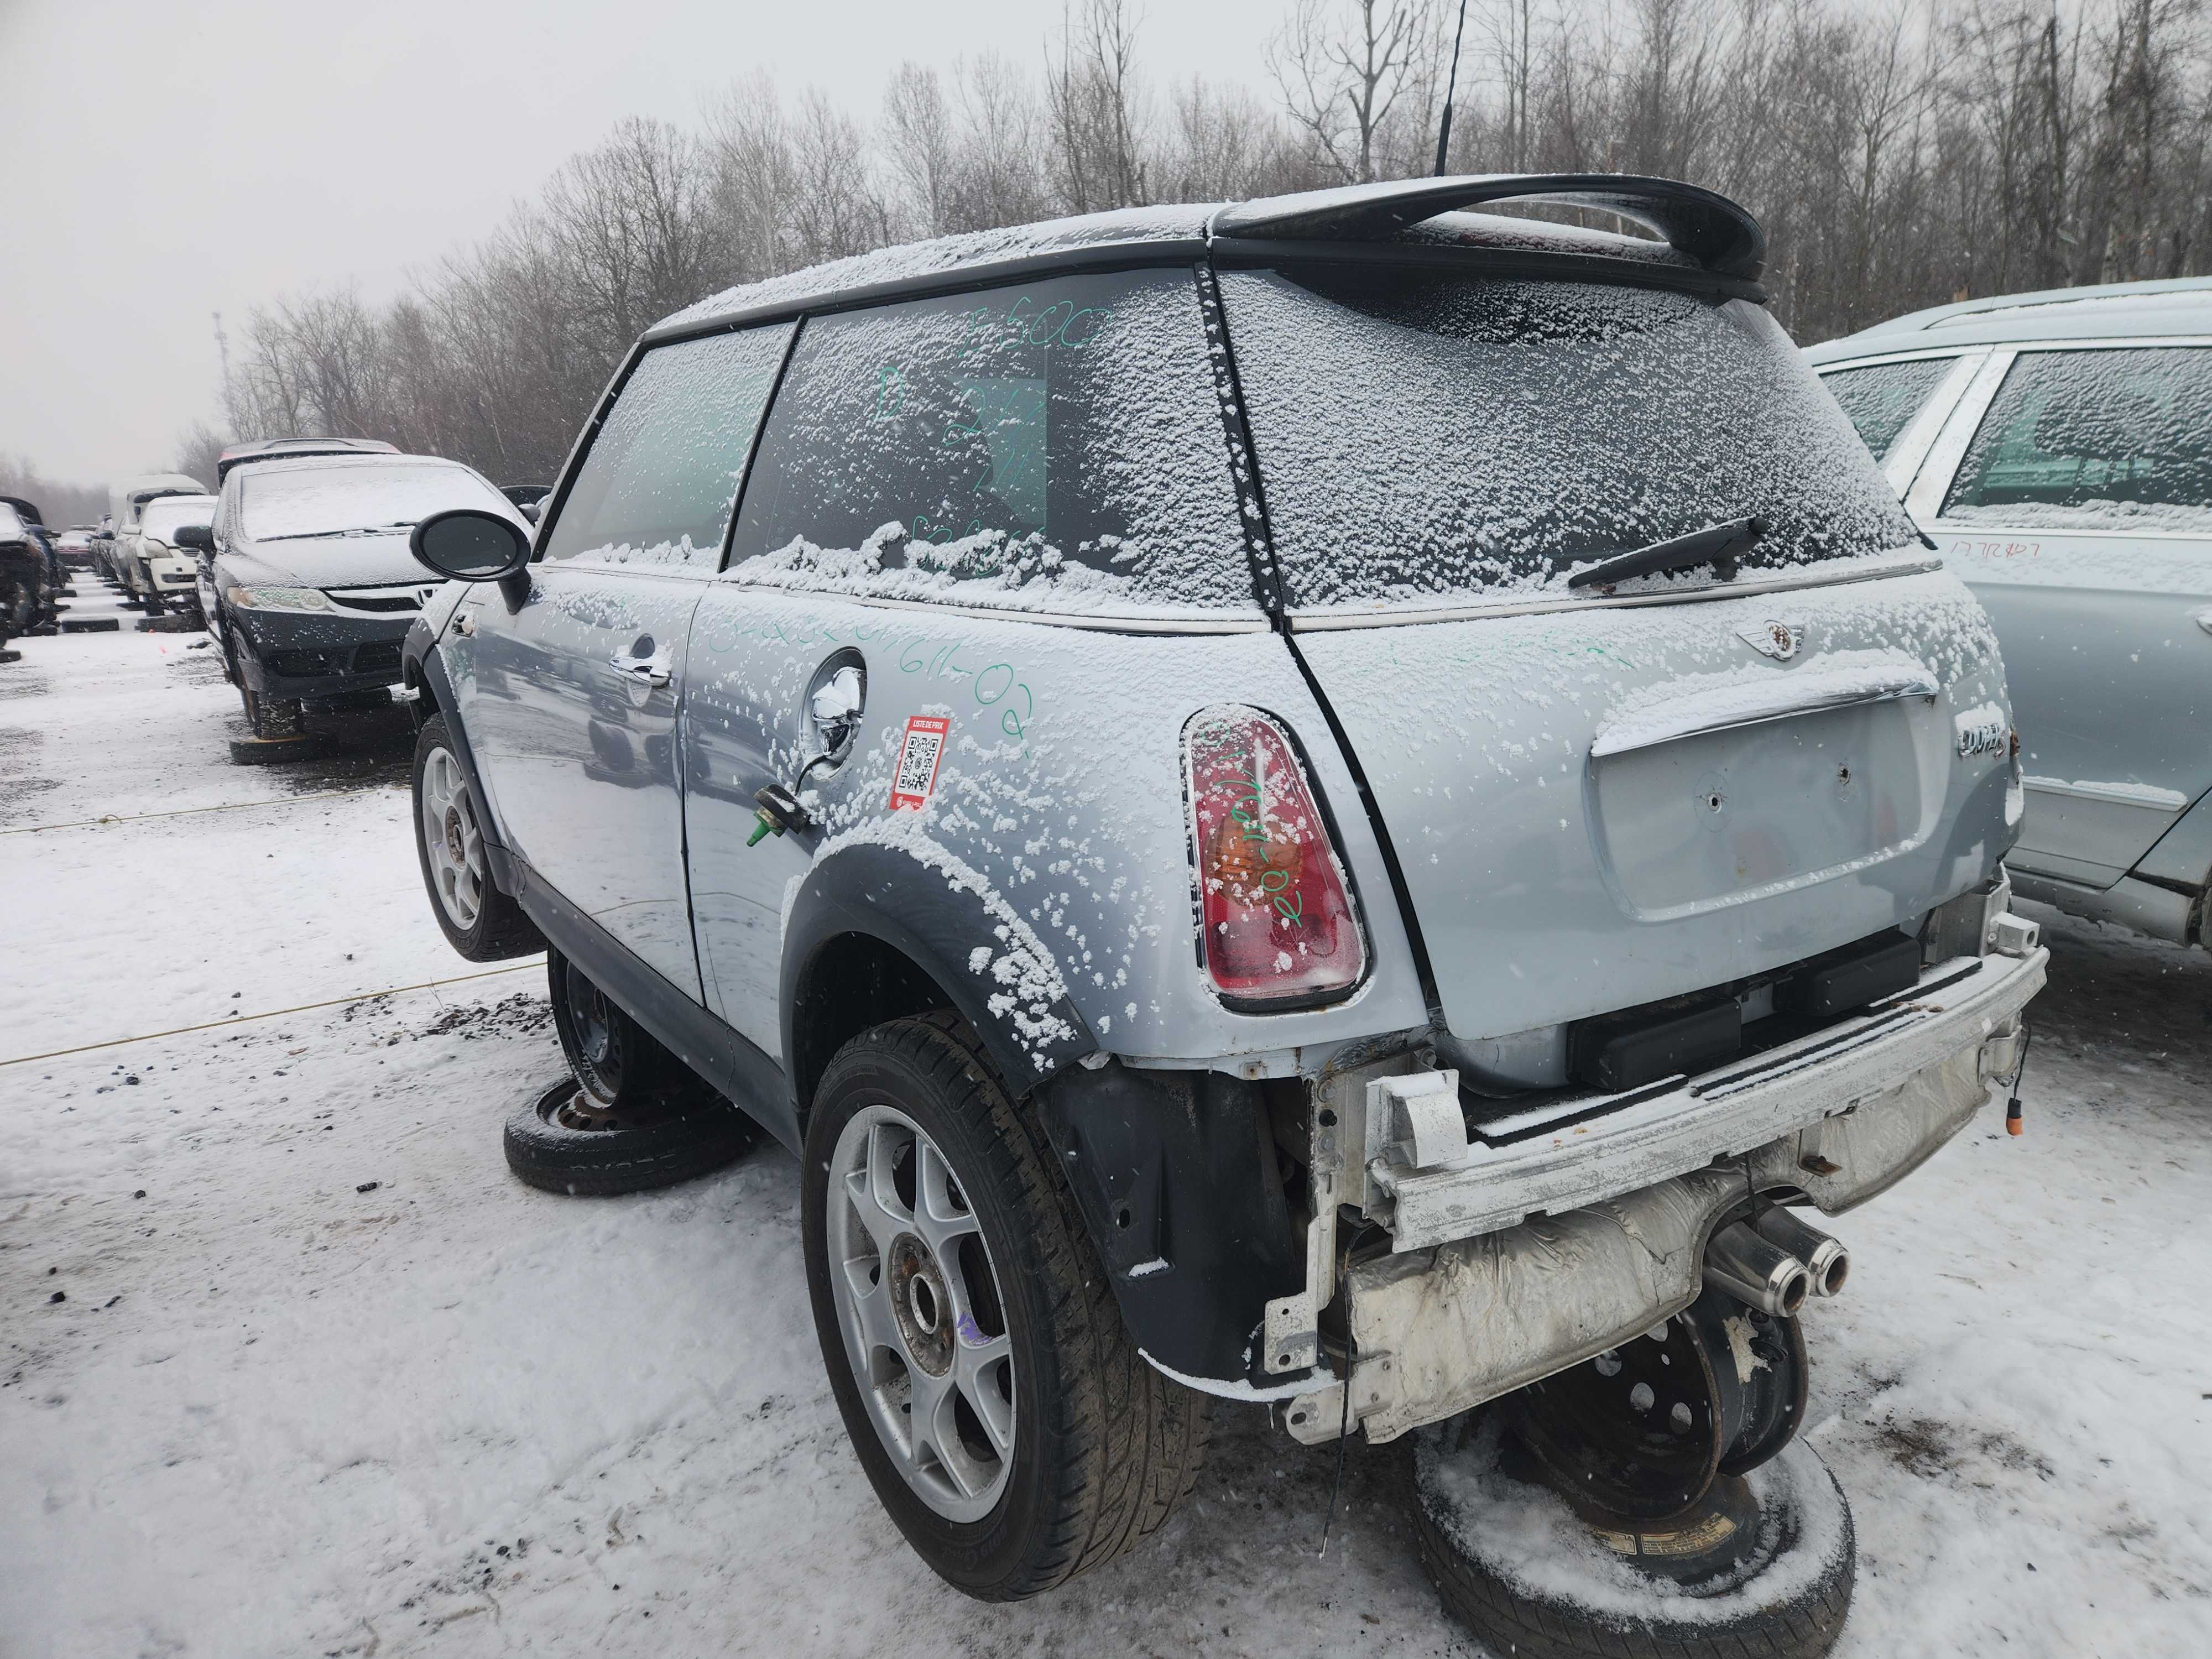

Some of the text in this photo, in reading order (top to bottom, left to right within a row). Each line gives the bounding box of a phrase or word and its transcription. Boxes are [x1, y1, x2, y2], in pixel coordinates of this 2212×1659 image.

[912, 719, 944, 730] LISTE DE PRIX
